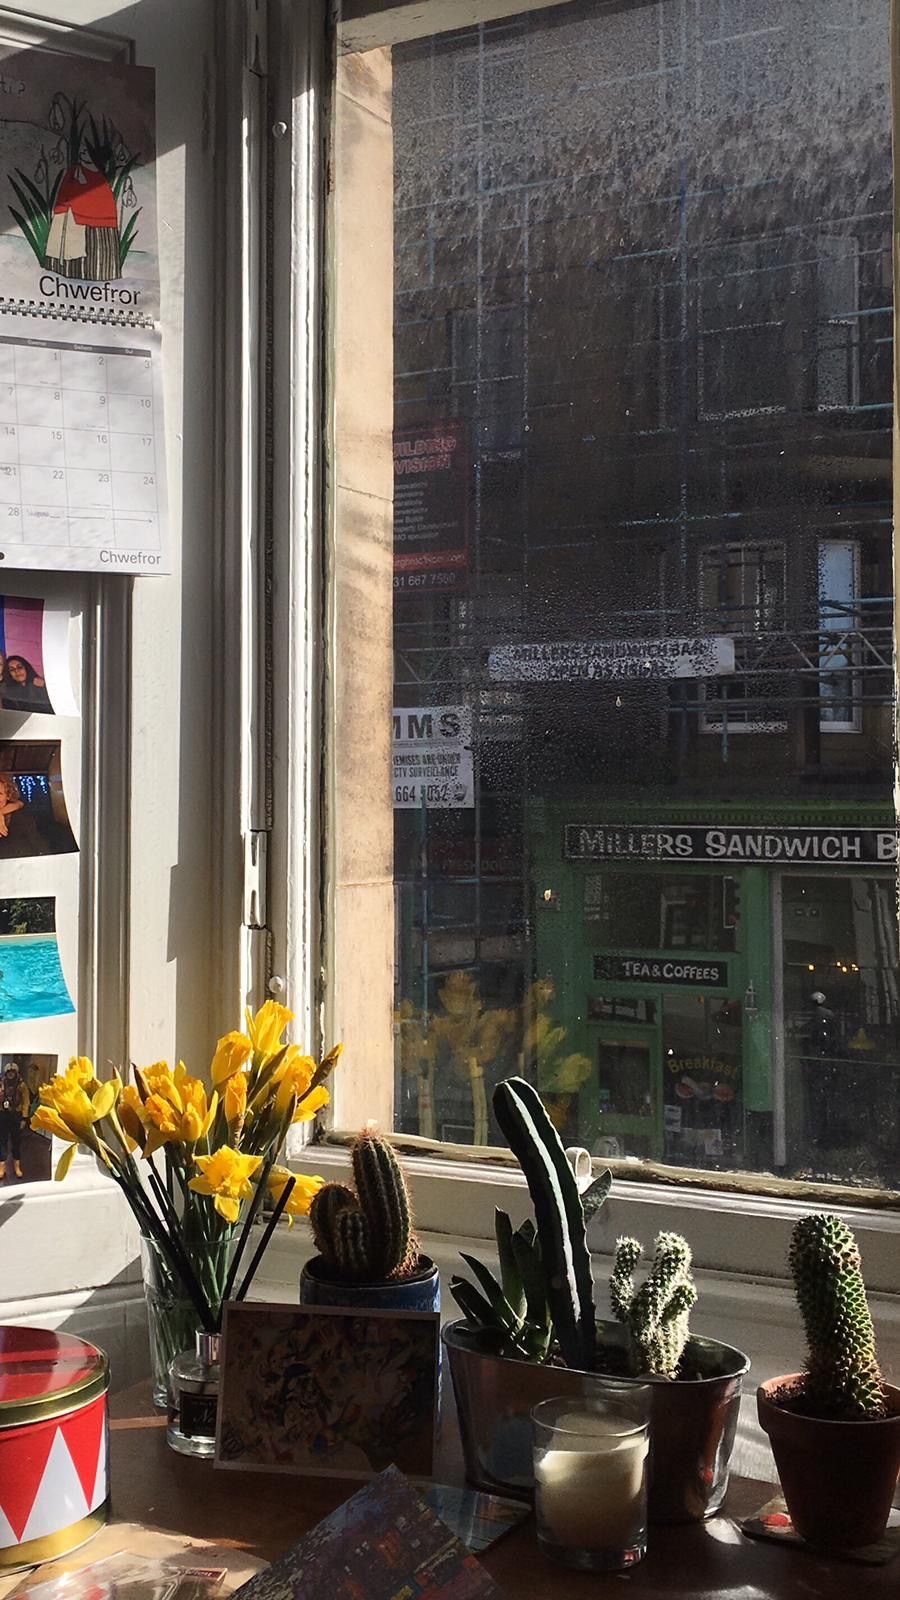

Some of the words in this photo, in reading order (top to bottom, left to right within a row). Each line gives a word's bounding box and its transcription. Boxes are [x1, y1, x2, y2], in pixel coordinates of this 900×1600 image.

[39, 275, 141, 305] Chwefror
[98, 357, 105, 366] 2
[144, 360, 150, 369] 3
[8, 387, 14, 396] 7
[54, 392, 60, 401] 8
[99, 396, 106, 405] 9
[140, 399, 151, 408] 10
[4, 427, 16, 436] 14
[51, 431, 63, 440] 15
[97, 435, 108, 444] 16
[142, 438, 153, 447] 17
[6, 467, 17, 476] 21
[53, 470, 64, 479] 22
[98, 474, 110, 483] 23
[143, 476, 154, 485] 24
[8, 507, 20, 517] 28
[99, 550, 161, 565] Chwefror
[395, 785, 416, 802] 664
[578, 829, 693, 855] MILLERS
[705, 831, 861, 859] SANDWICH
[667, 1058, 738, 1078] Breakfast
